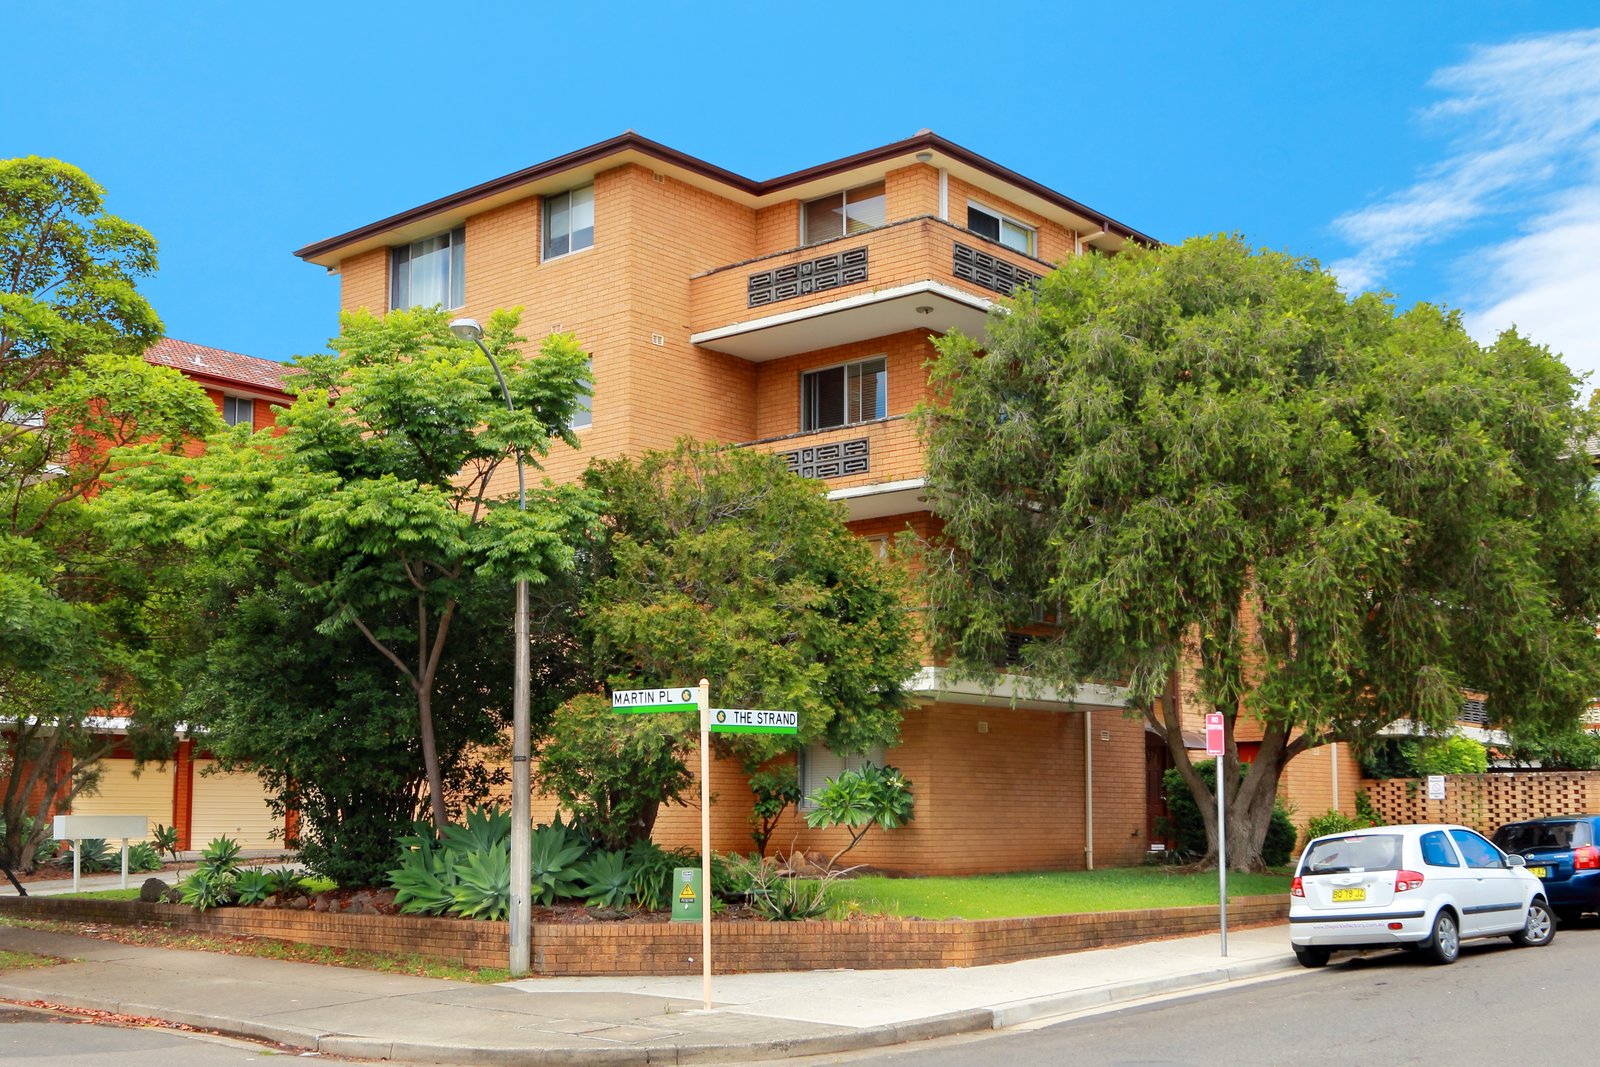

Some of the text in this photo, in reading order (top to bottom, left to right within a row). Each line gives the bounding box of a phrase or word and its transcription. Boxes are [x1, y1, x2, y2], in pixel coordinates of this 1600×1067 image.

[614, 690, 673, 705] MARTIN PL
[734, 711, 796, 725] THE STRAND
[1211, 716, 1219, 724] NO
